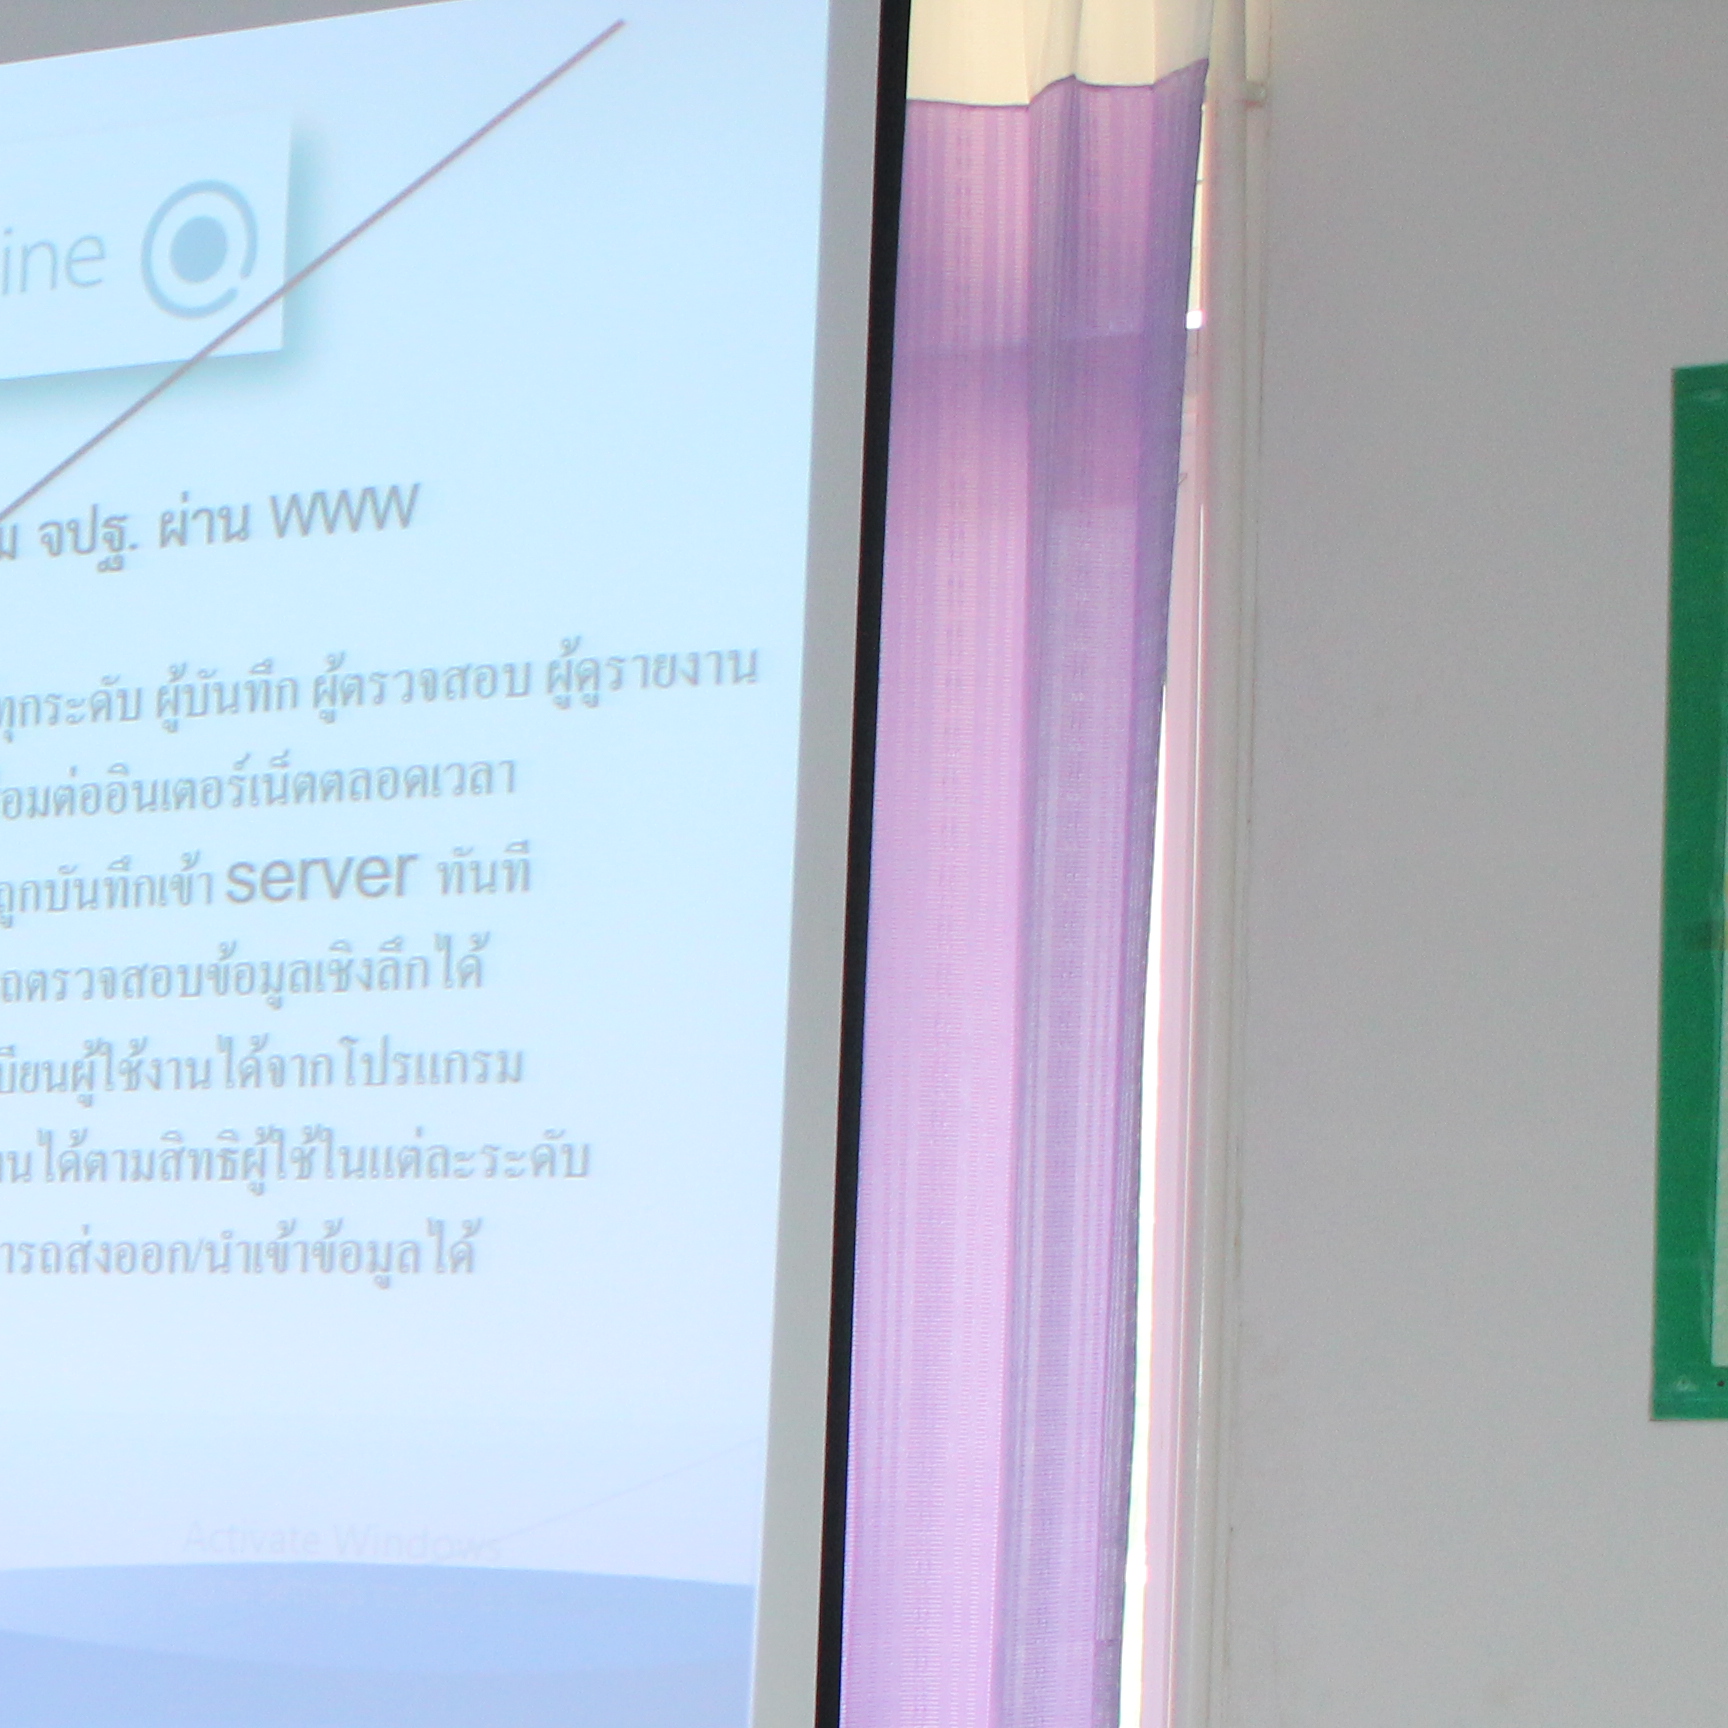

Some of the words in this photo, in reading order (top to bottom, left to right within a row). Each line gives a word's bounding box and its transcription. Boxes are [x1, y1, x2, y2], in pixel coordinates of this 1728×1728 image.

[39, 504, 138, 572] จปฐ.
[158, 491, 250, 548] ผ่าน
[270, 483, 421, 538] WWW
[156, 657, 298, 733] ผู้บันทึก
[312, 651, 533, 724] ผู้ตรวจสอบ
[547, 635, 759, 710] ผู้ดูรายงาน
[225, 853, 418, 903] server
[437, 839, 531, 896] ทันที
[182, 1519, 321, 1555] Activate
[332, 1522, 504, 1562] Windows
